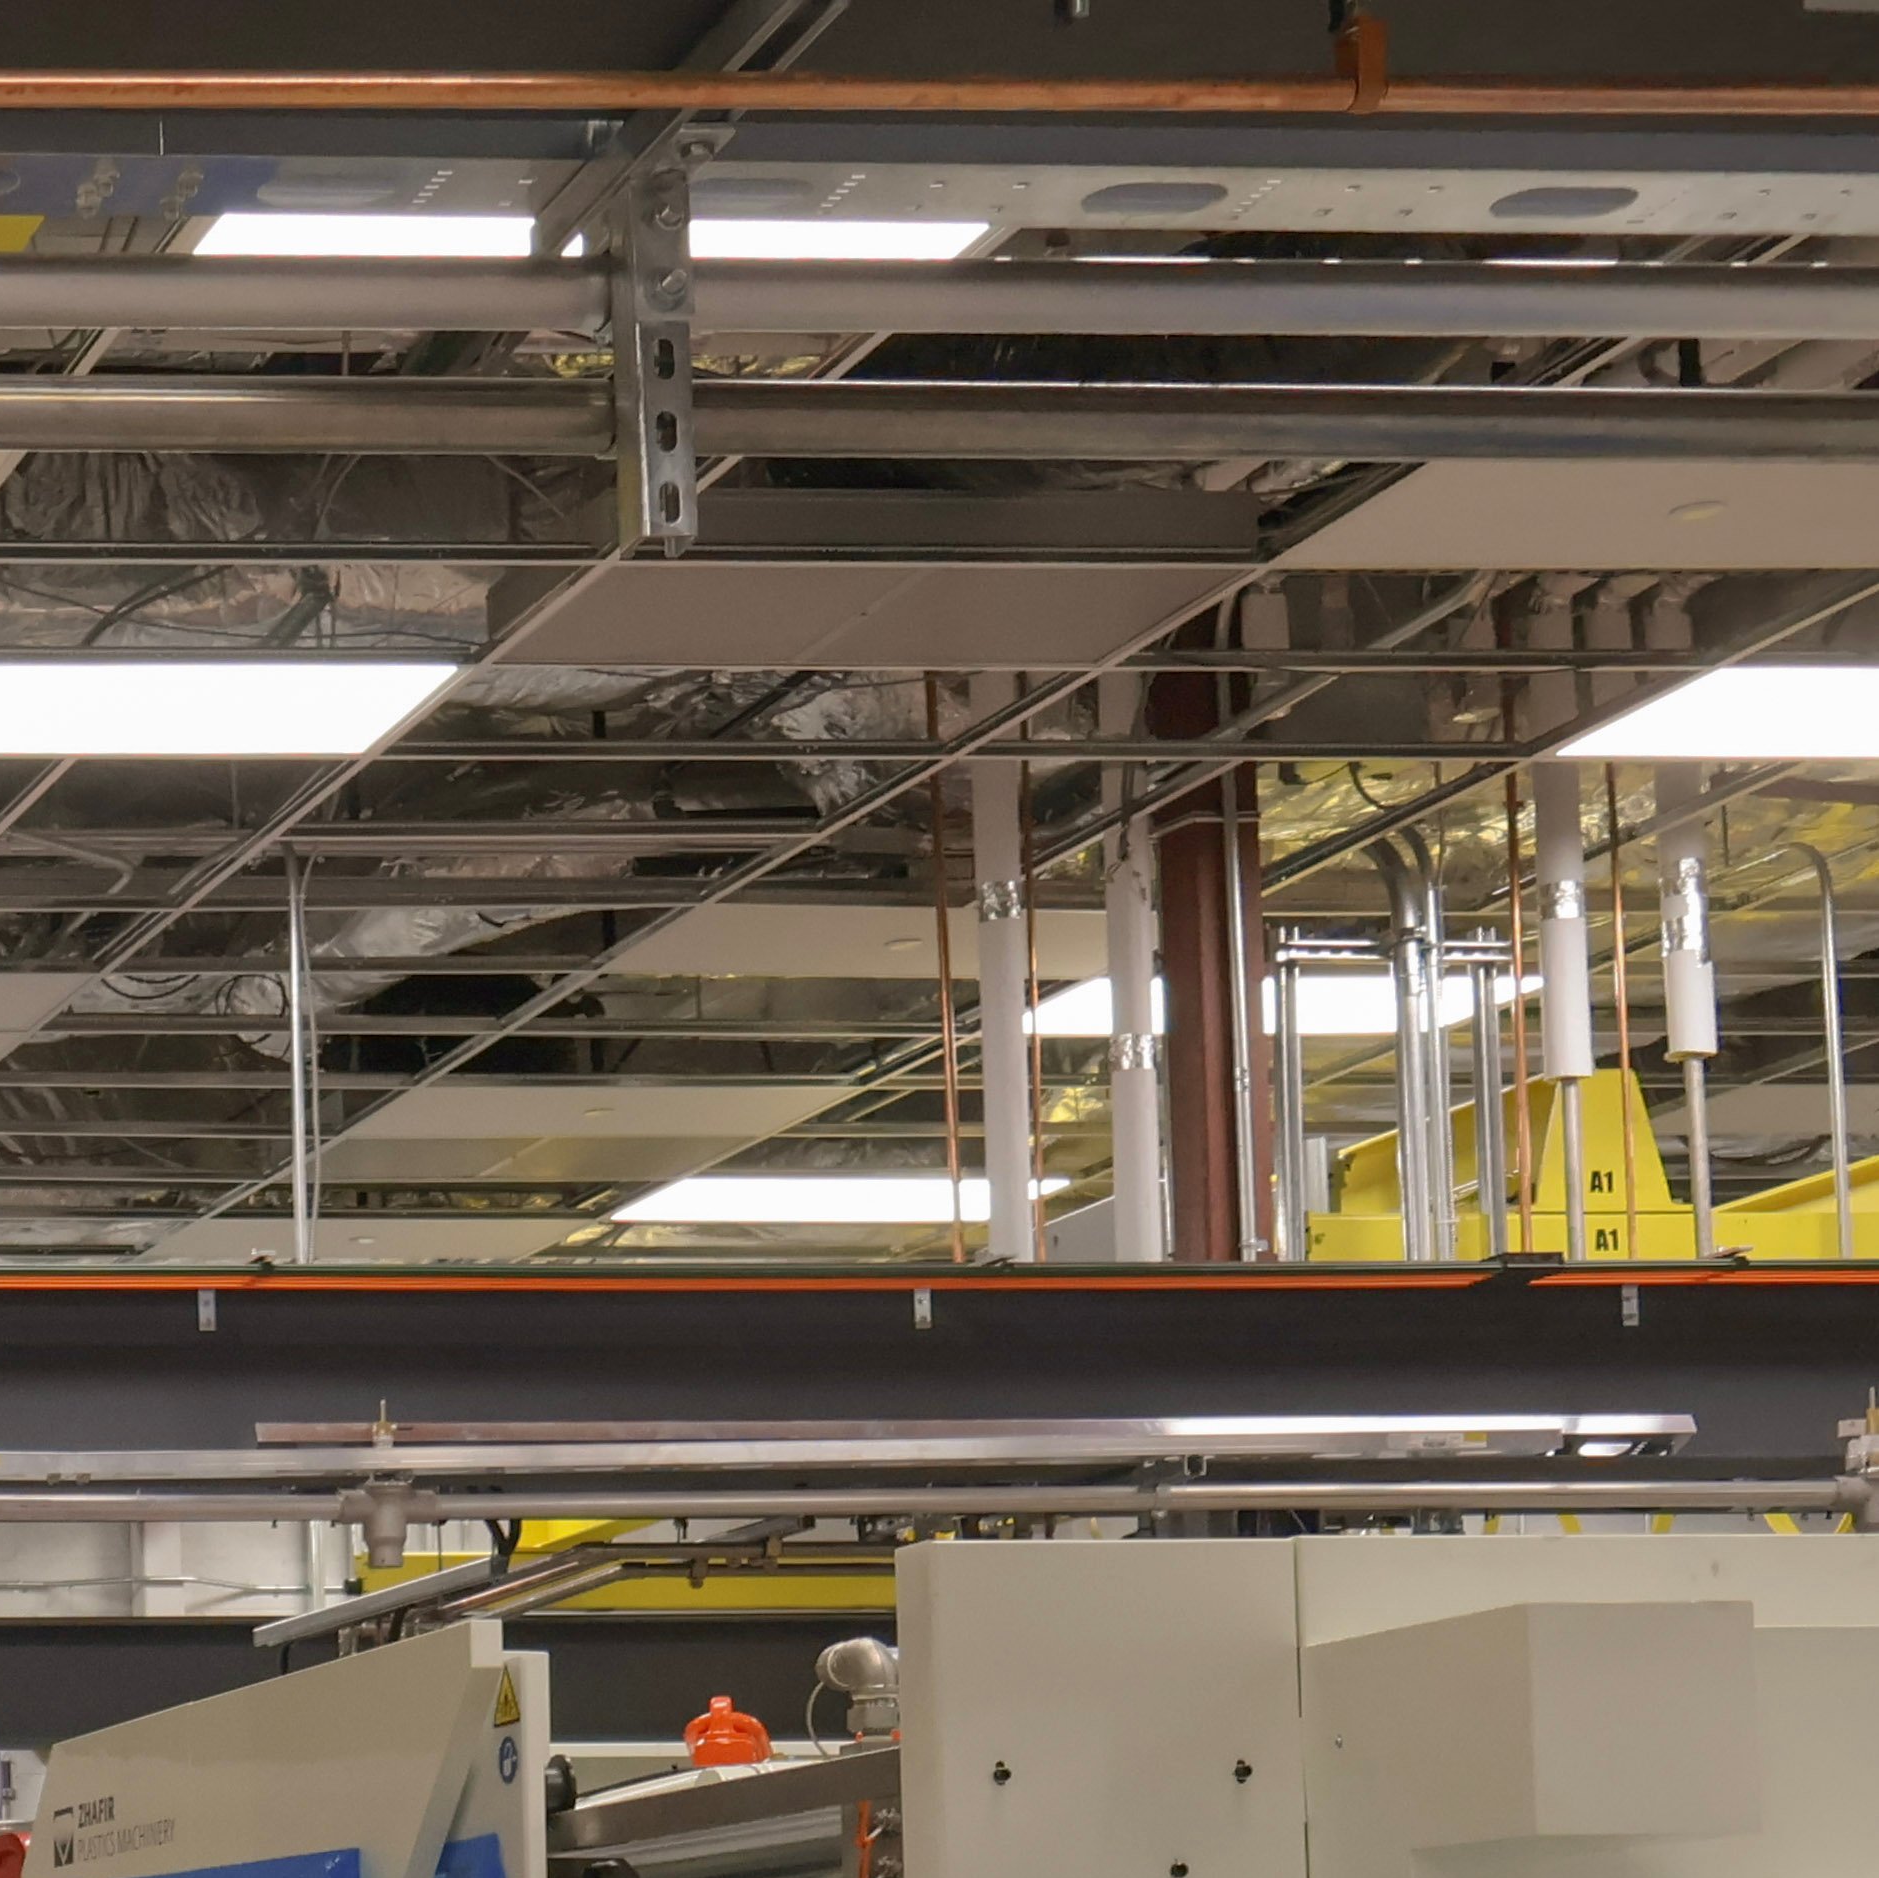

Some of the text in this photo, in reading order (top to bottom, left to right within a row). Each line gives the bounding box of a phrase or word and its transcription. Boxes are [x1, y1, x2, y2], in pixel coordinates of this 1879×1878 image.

[1590, 1170, 1613, 1193] A1
[1595, 1229, 1618, 1251] A1
[78, 1796, 114, 1828] ZHAFIR
